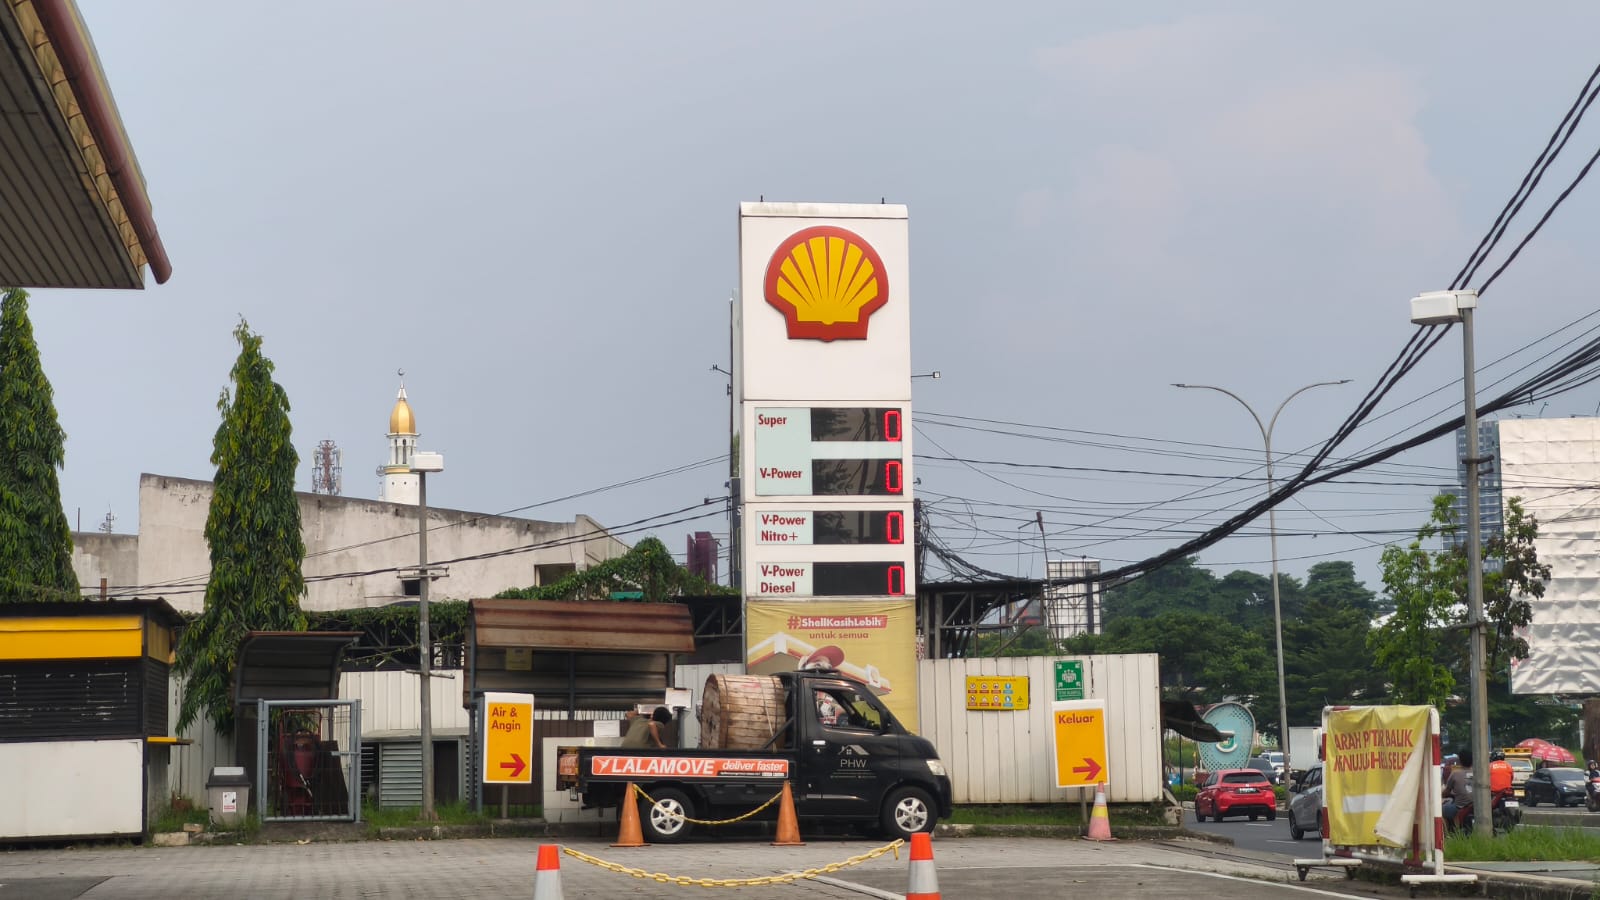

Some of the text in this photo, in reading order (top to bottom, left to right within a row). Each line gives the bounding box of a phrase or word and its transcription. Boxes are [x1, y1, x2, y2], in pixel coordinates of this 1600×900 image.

[758, 414, 787, 427] Super
[884, 410, 901, 442] 0
[760, 467, 803, 479] V-Power
[885, 460, 902, 493] 0
[762, 515, 806, 525] V-Power
[886, 511, 903, 544] 0
[761, 530, 798, 542] Nitro+
[761, 565, 805, 577] V-Power
[887, 565, 905, 596] 0
[760, 581, 796, 593] Diesel
[787, 615, 881, 630] #ShellKasihLebih
[809, 631, 836, 639] untuk
[492, 706, 517, 717] Air &
[1058, 713, 1095, 724] Keluar
[491, 719, 521, 732] Angin
[1335, 732, 1361, 750] ARAH
[612, 758, 715, 775] LALAMOVE
[722, 760, 755, 770] deliver
[757, 760, 784, 771] faster
[840, 759, 867, 768] PHW
